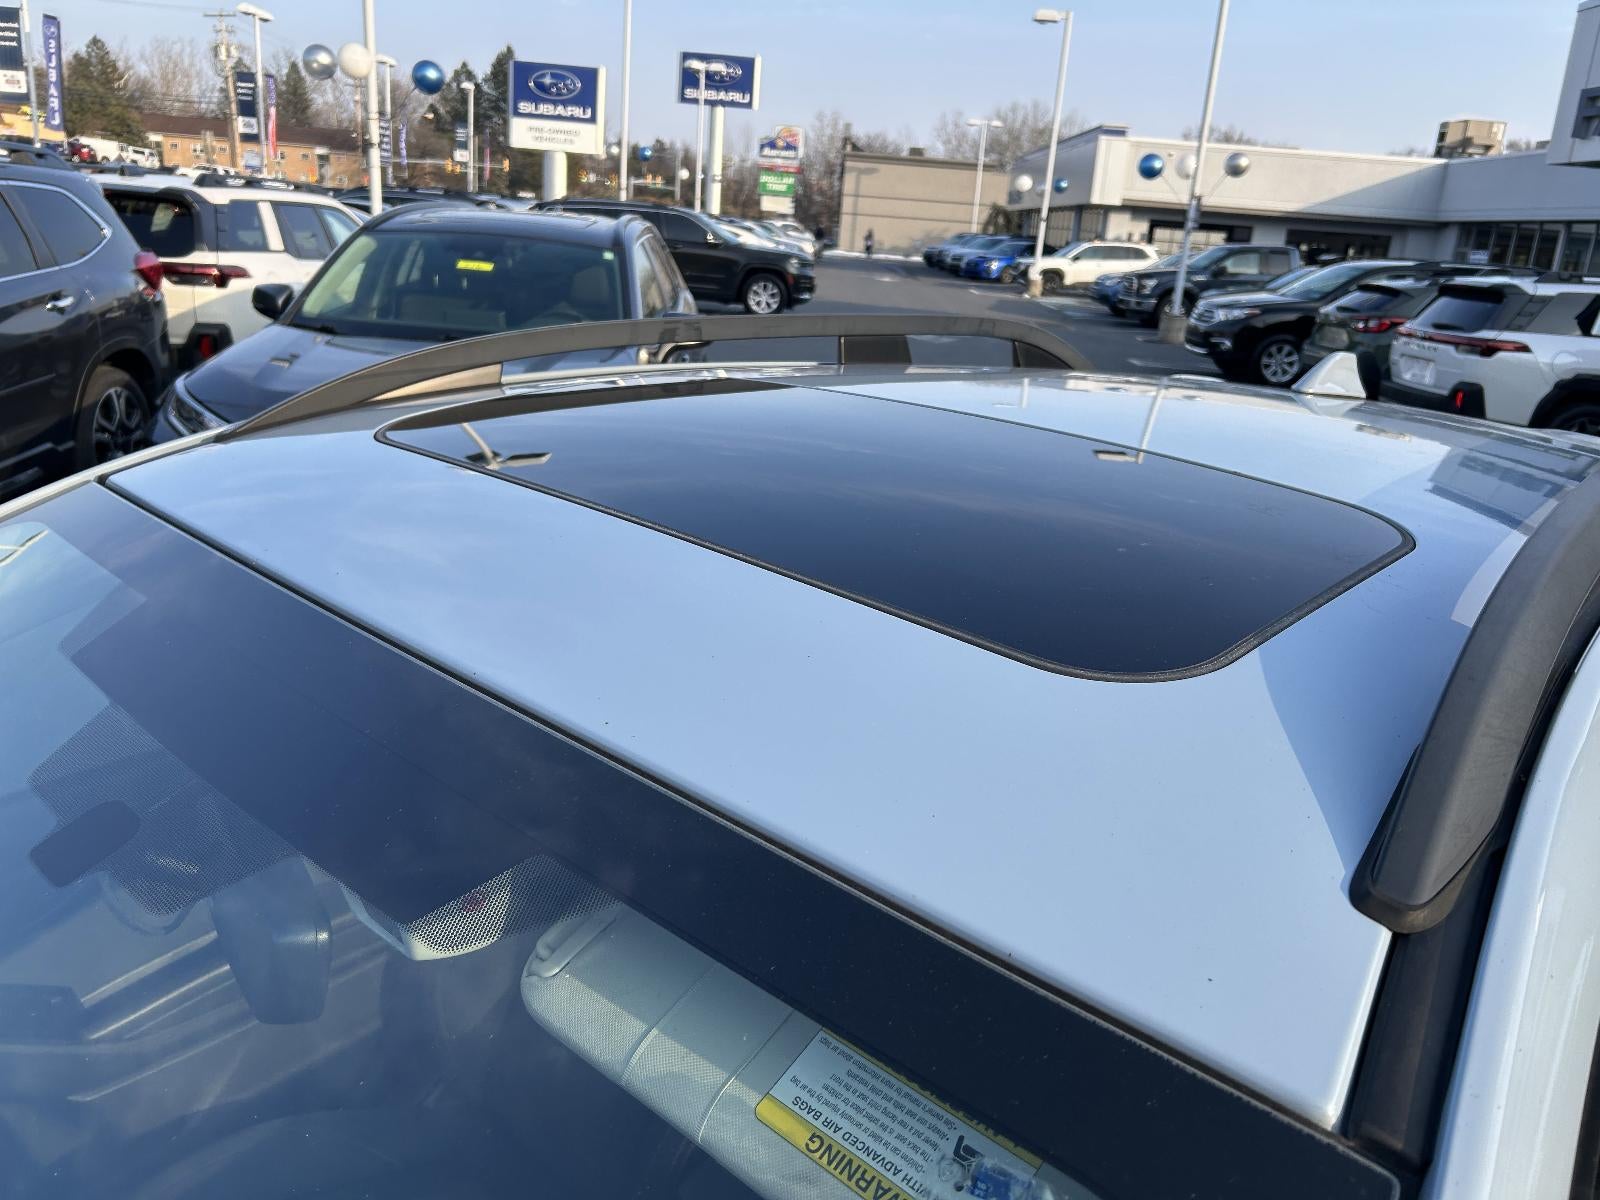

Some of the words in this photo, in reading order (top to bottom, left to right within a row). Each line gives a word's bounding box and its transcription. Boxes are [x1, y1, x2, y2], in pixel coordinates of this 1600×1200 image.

[683, 88, 751, 103] SUBARU
[517, 101, 592, 119] SUBARU
[790, 1094, 823, 1121] BAGS
[820, 1115, 843, 1135] AIR
[837, 1109, 864, 1131] seriously
[840, 1129, 902, 1176] ADVANCED
[889, 1144, 902, 1155] can
[918, 1149, 931, 1161] The
[898, 1151, 924, 1173] Children
